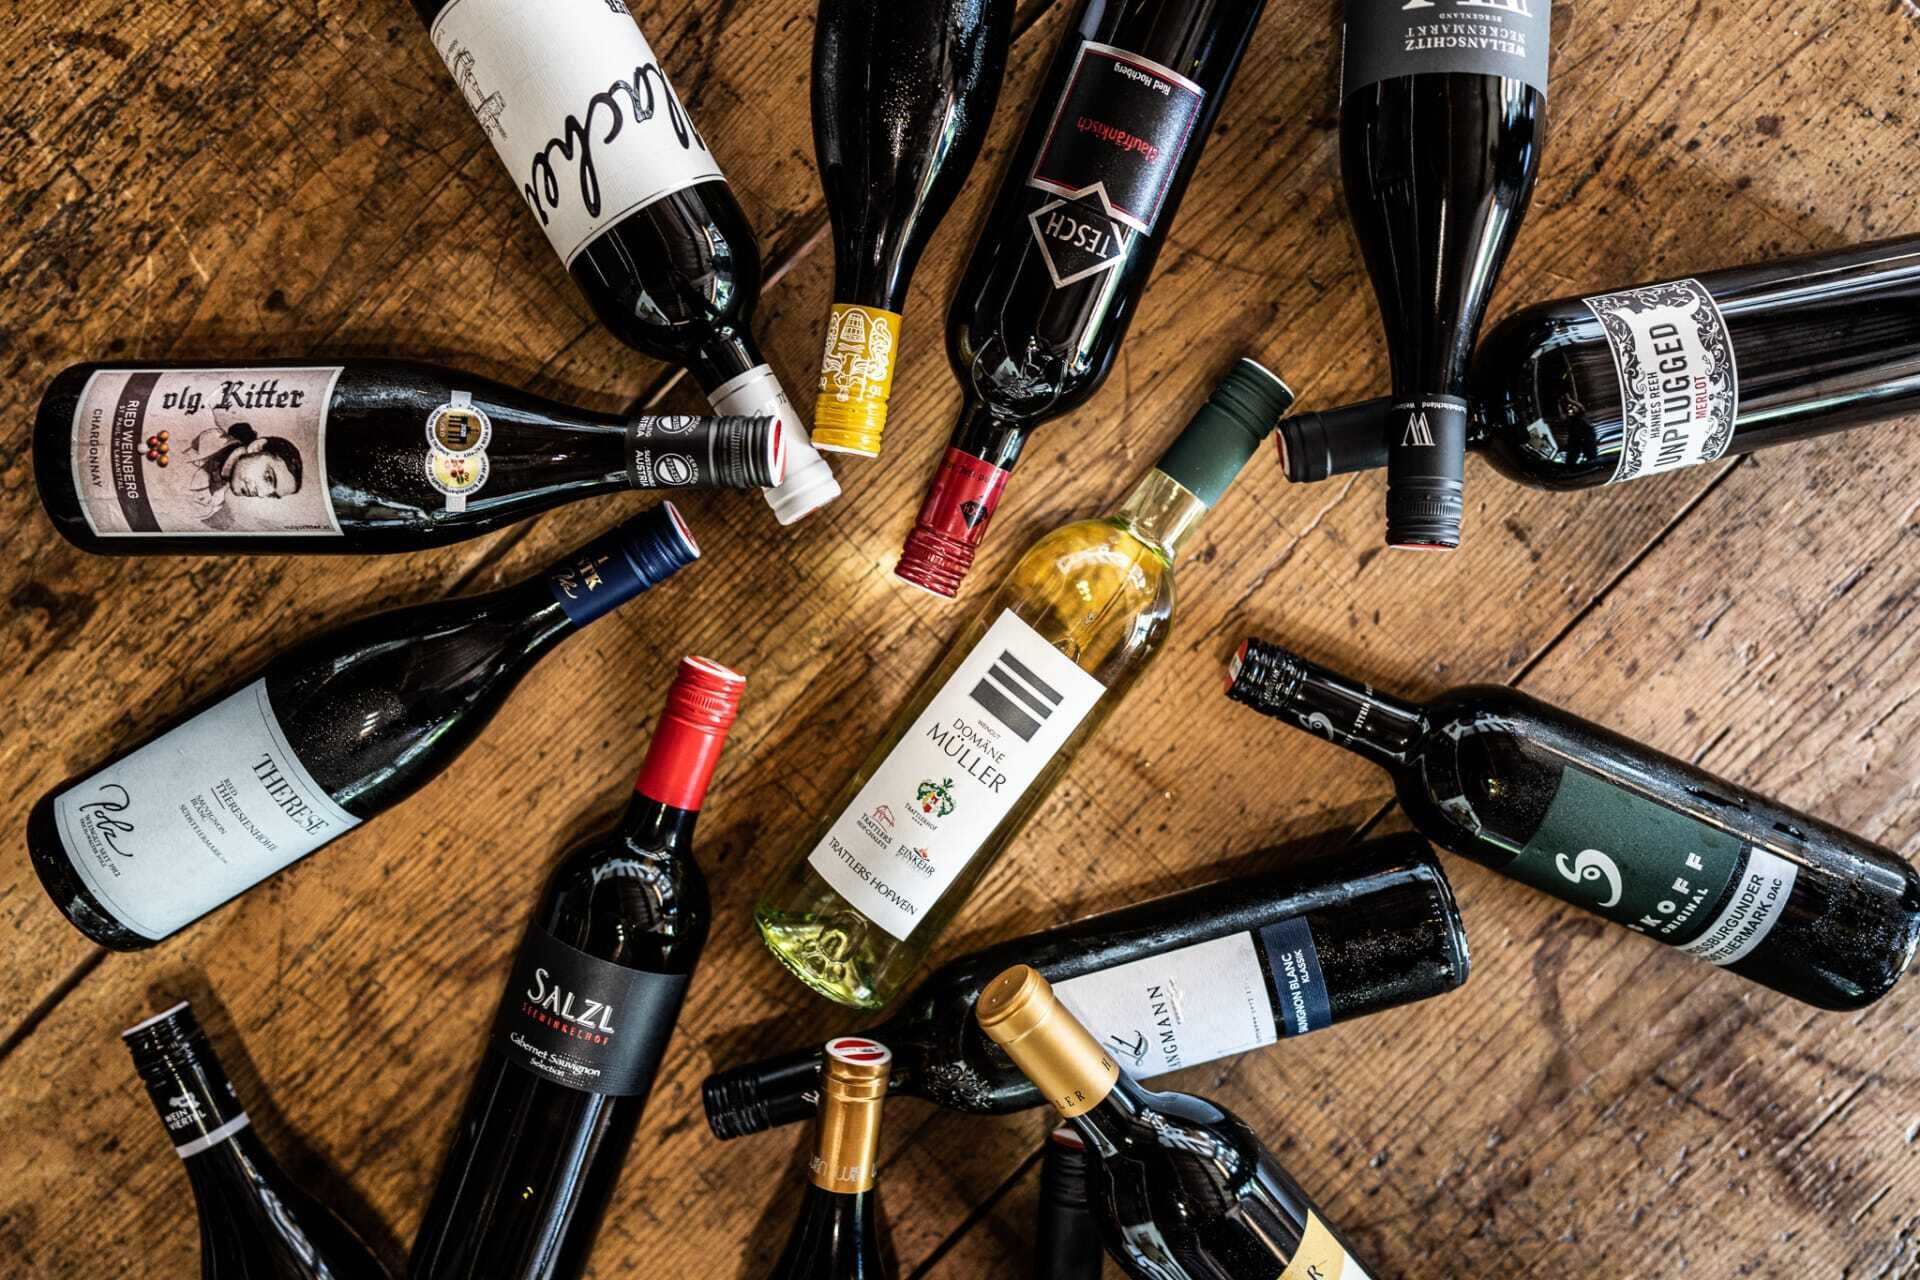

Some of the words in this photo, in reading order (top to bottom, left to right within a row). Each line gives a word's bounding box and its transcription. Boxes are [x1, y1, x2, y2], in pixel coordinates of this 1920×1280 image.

[1406, 23, 1524, 42] NECKENMARKT
[1438, 12, 1501, 21] BURGENLAND
[1405, 35, 1525, 57] WELLANSCHITZ
[1112, 61, 1152, 86] Hochberg
[1151, 79, 1171, 96] Ried
[1044, 211, 1110, 259] TESCH
[212, 378, 304, 411] Ritter
[1647, 371, 1660, 397] REEH
[1648, 324, 1690, 466] UNPLUGGED
[1694, 376, 1706, 418] MERLOT
[123, 400, 139, 426] RIED
[1650, 401, 1661, 438] HANNES
[88, 408, 102, 486] CHARDONNAY
[121, 429, 139, 499] WEINBERG
[633, 449, 649, 487] AUSTRIA
[925, 721, 1008, 794] MÜLLER
[952, 717, 1005, 764] DOMÄNE
[189, 797, 208, 820] BLANC
[251, 751, 329, 837] THERESE
[195, 793, 227, 834] SAUVIGNON
[861, 812, 893, 844] TRATTLERS
[904, 802, 938, 831] TRATTLERHOF
[828, 836, 872, 881] TRATTLERS
[869, 876, 918, 916] HOFWEIN
[898, 844, 936, 875] EINKEHR
[1766, 877, 1783, 901] DAC
[1660, 885, 1709, 934] ORIGINAL
[1282, 953, 1299, 989] BLANC
[1294, 948, 1309, 982] KLASSIK
[526, 967, 614, 1034] SALZL
[521, 1002, 609, 1045] SEEWINKELHOF
[511, 1031, 548, 1059] Cabernet
[548, 1053, 600, 1077] Sauvignon
[530, 1057, 565, 1076] Selection
[164, 1107, 188, 1122] WEIN
[168, 1109, 206, 1130] VIERTL
